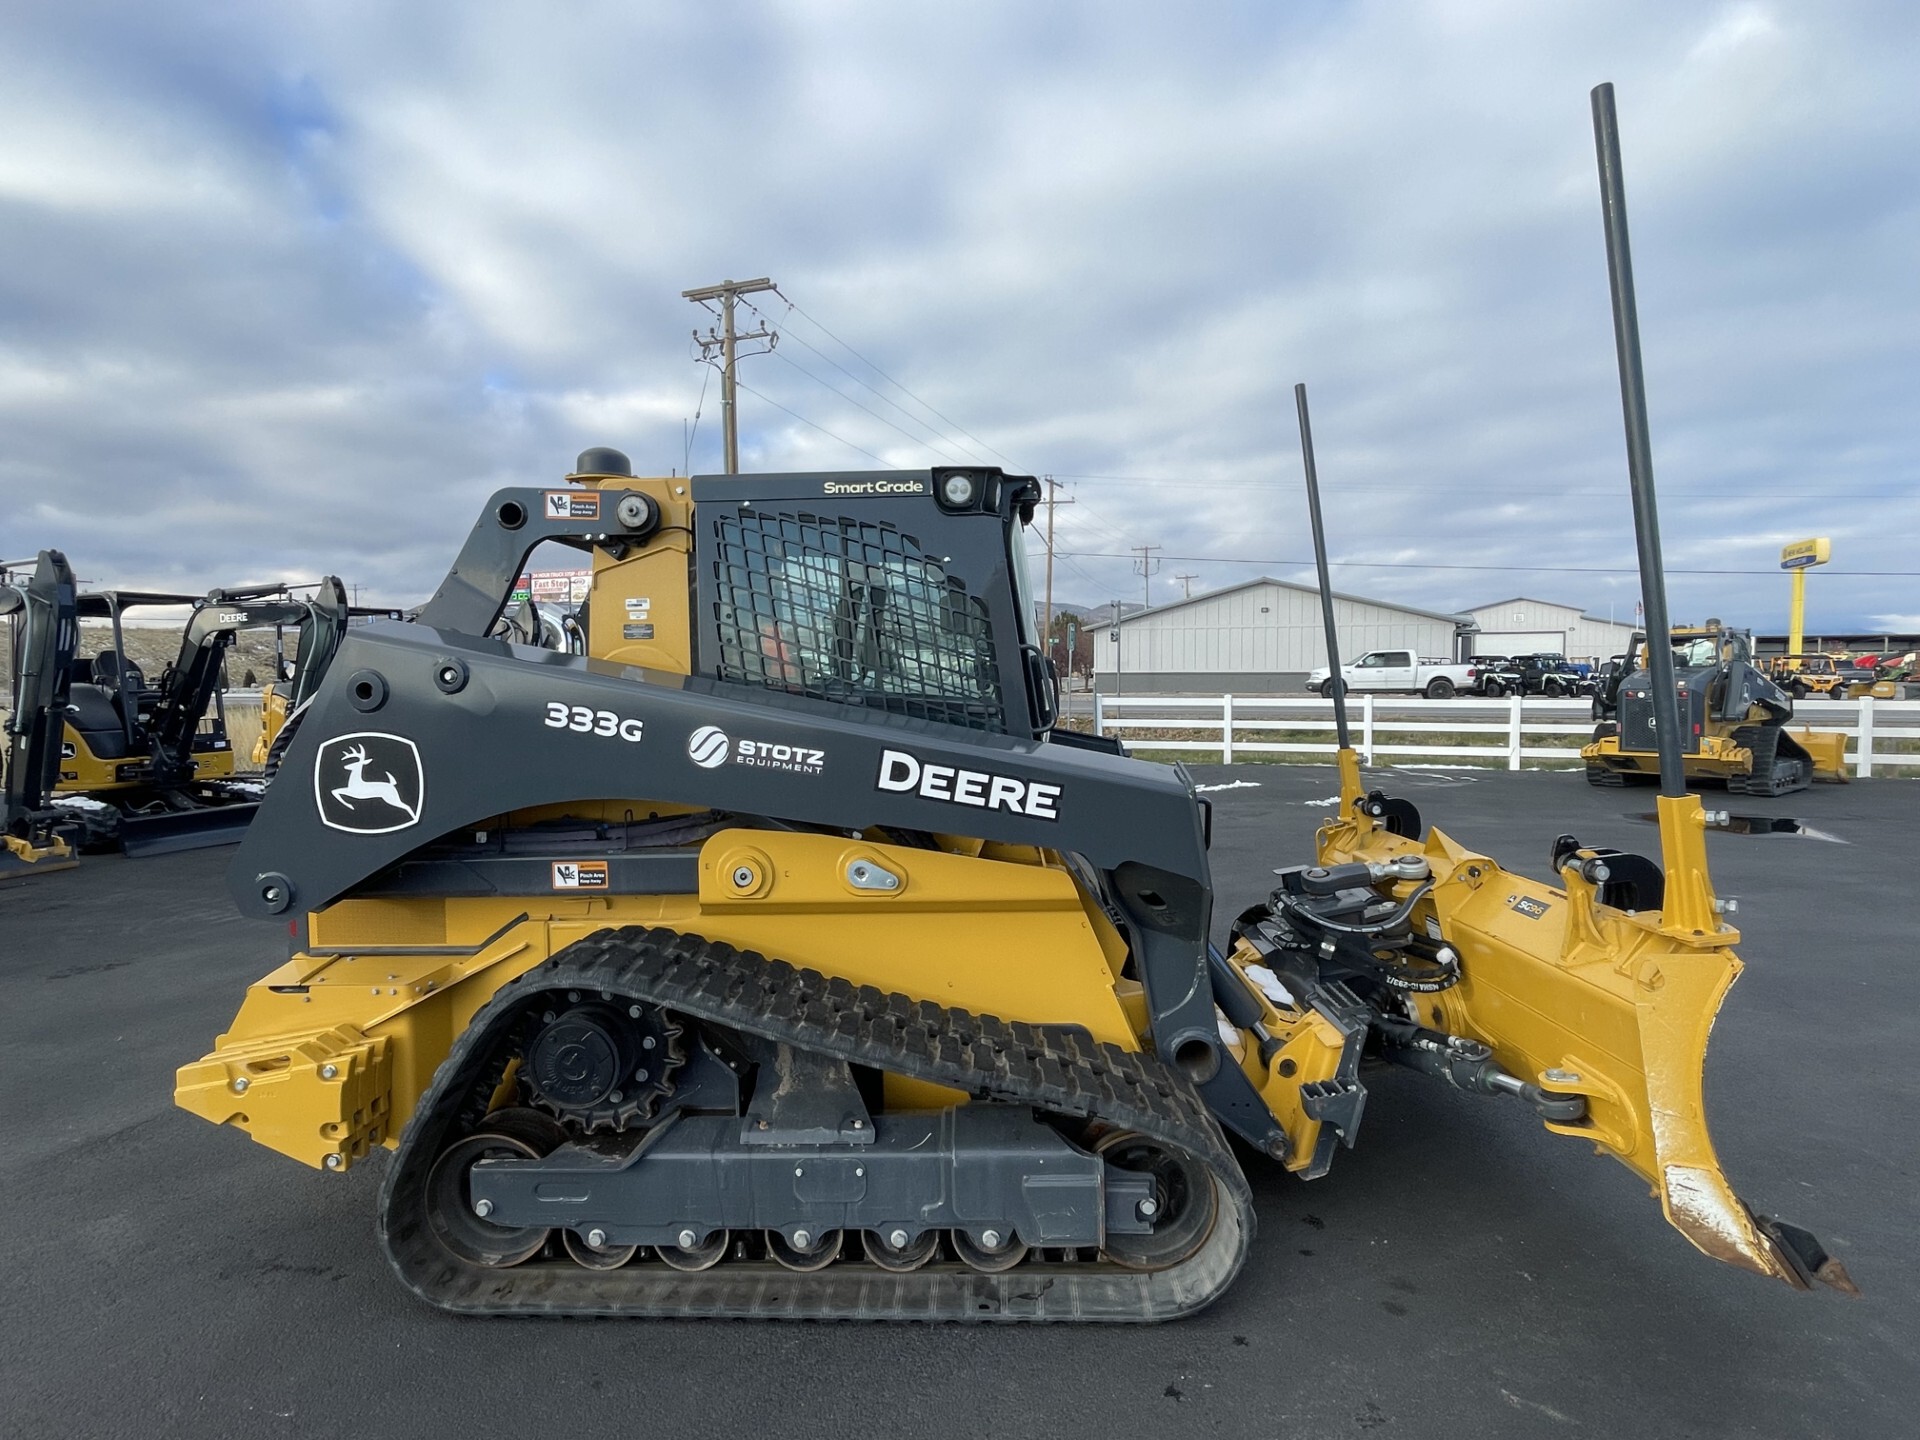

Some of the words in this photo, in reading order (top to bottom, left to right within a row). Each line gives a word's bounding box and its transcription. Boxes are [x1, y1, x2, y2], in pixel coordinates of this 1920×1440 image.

[534, 580, 550, 588] Fast
[551, 579, 568, 588] Stop
[220, 612, 248, 623] DEERE
[544, 702, 644, 742] 333G
[738, 740, 825, 765] STOTZ
[736, 756, 823, 774] EQUIPMENT
[878, 749, 1061, 819] DEERE
[1517, 900, 1545, 915] SG96
